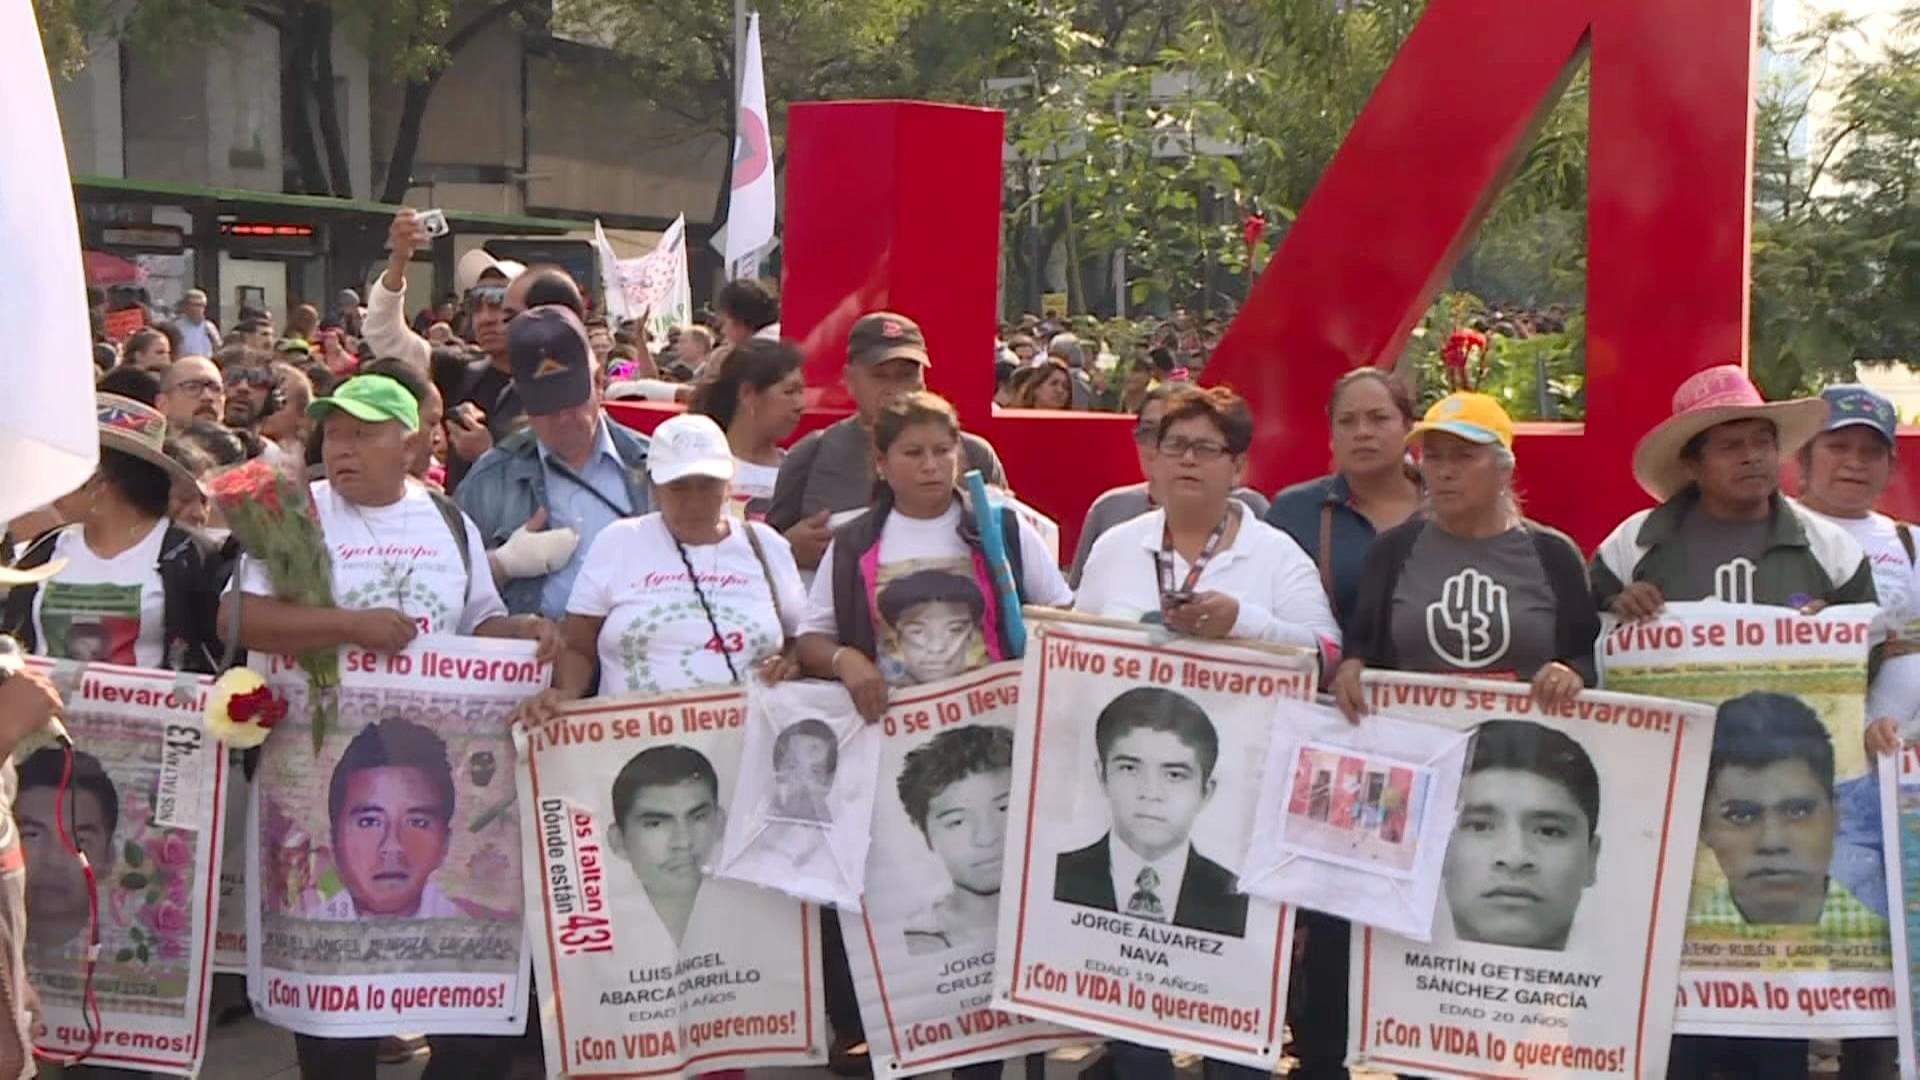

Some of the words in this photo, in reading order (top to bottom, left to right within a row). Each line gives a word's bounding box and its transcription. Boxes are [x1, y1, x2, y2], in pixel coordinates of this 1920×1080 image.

[704, 631, 745, 653] 43
[1692, 623, 1726, 647] se
[1735, 619, 1765, 646] lo
[346, 650, 377, 673] se
[421, 651, 545, 684] llevaron!
[1048, 644, 1106, 674] ¡Vivo
[1113, 655, 1141, 678] se
[1150, 656, 1173, 684] lo
[1465, 689, 1496, 711] se
[612, 717, 641, 740] se
[648, 711, 674, 736] lo
[903, 710, 930, 734] se
[936, 702, 961, 725] lo
[167, 725, 201, 756] 43
[542, 799, 568, 859] Dónde
[574, 813, 594, 839] os
[551, 864, 578, 914] están
[579, 845, 604, 912] faltan
[1071, 911, 1135, 936] JORGE
[1138, 923, 1224, 956] ÁLVAREZ
[1120, 944, 1169, 967] NAVA
[1405, 952, 1475, 976] MARTÍN
[1480, 963, 1604, 989] GETSEMANY
[629, 966, 673, 984] LUIS
[936, 972, 993, 995] CRUZ
[1085, 959, 1129, 977] EDAD
[1136, 970, 1155, 983] 19
[1159, 975, 1210, 995] AÑOS
[1416, 975, 1509, 1002] SÁNCHEZ
[1515, 988, 1588, 1009] GARCÍA
[267, 977, 300, 1009] ¡Con
[306, 981, 360, 1012] VIDA
[367, 984, 386, 1011] lo
[391, 982, 506, 1014] queremos!
[600, 985, 677, 1006] ABARCA
[1025, 963, 1067, 993] ¡Con
[1075, 971, 1121, 1007] VIDA
[1128, 983, 1146, 1010] lo
[1151, 994, 1261, 1035] queremos!
[1694, 981, 1760, 1009] VIDA
[1764, 981, 1790, 1011] lo
[1797, 985, 1897, 1017] querem
[629, 1007, 677, 1022] EDAD
[905, 1022, 952, 1051] ¡Con
[957, 1008, 1010, 1036] VIDA
[1439, 1002, 1486, 1019] EDAD
[1492, 1011, 1515, 1024] 20
[1520, 1013, 1570, 1028] AÑOS
[575, 1036, 616, 1066] ¡Con
[622, 1030, 677, 1060] VIDA
[689, 1009, 797, 1047] queremos!
[1375, 1017, 1421, 1048] ¡Con
[1429, 1022, 1480, 1057] VIDA
[1487, 1032, 1507, 1062] lo
[1513, 1040, 1626, 1073] queremos!
